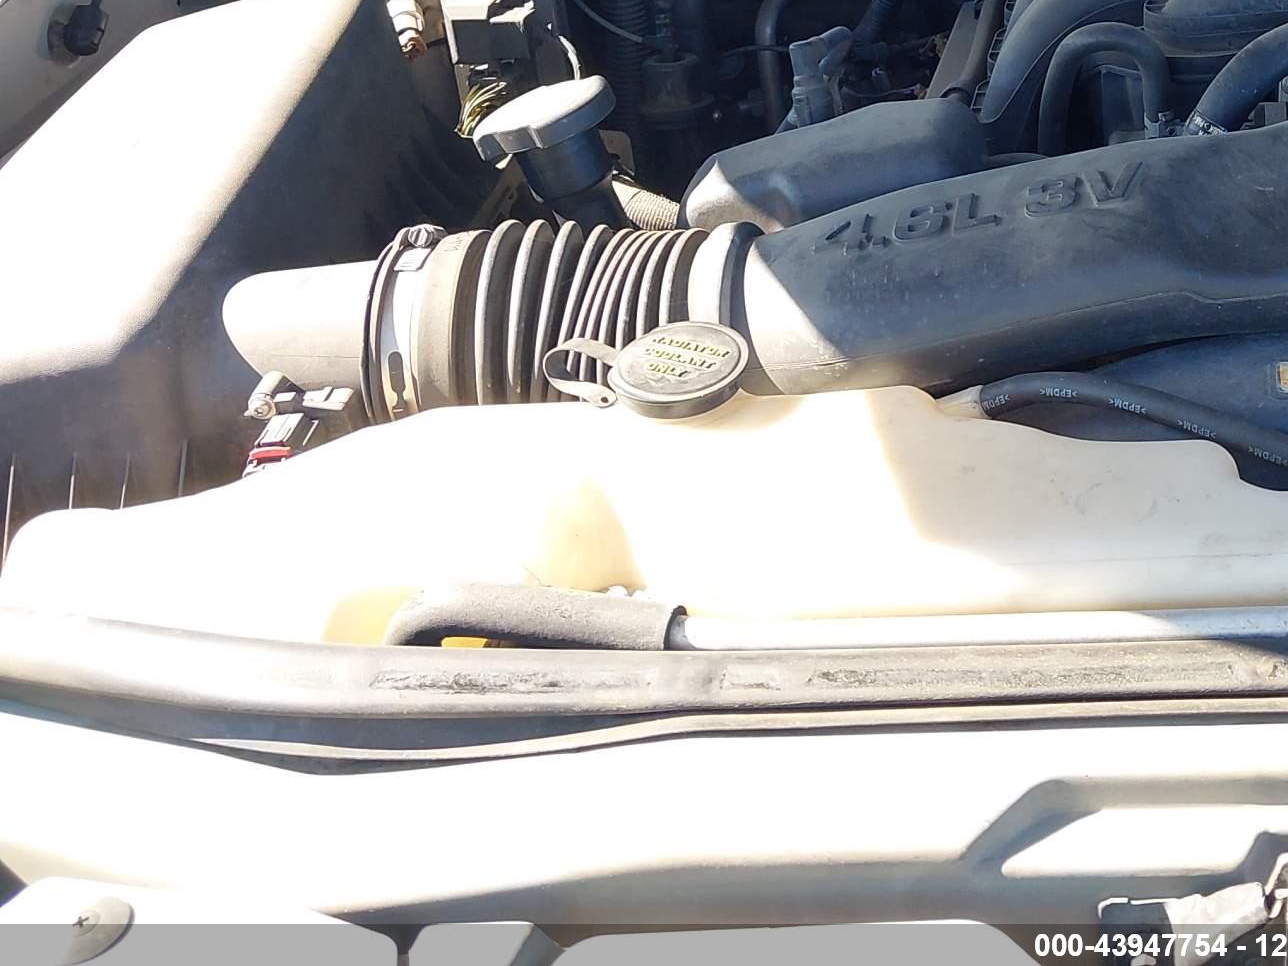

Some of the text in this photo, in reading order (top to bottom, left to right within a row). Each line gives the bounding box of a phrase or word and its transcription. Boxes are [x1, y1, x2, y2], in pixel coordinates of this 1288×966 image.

[811, 161, 1144, 256] 4.6L 3V
[645, 347, 718, 369] COOLANT
[652, 336, 731, 359] RADIATOR
[647, 362, 691, 378] ONLY
